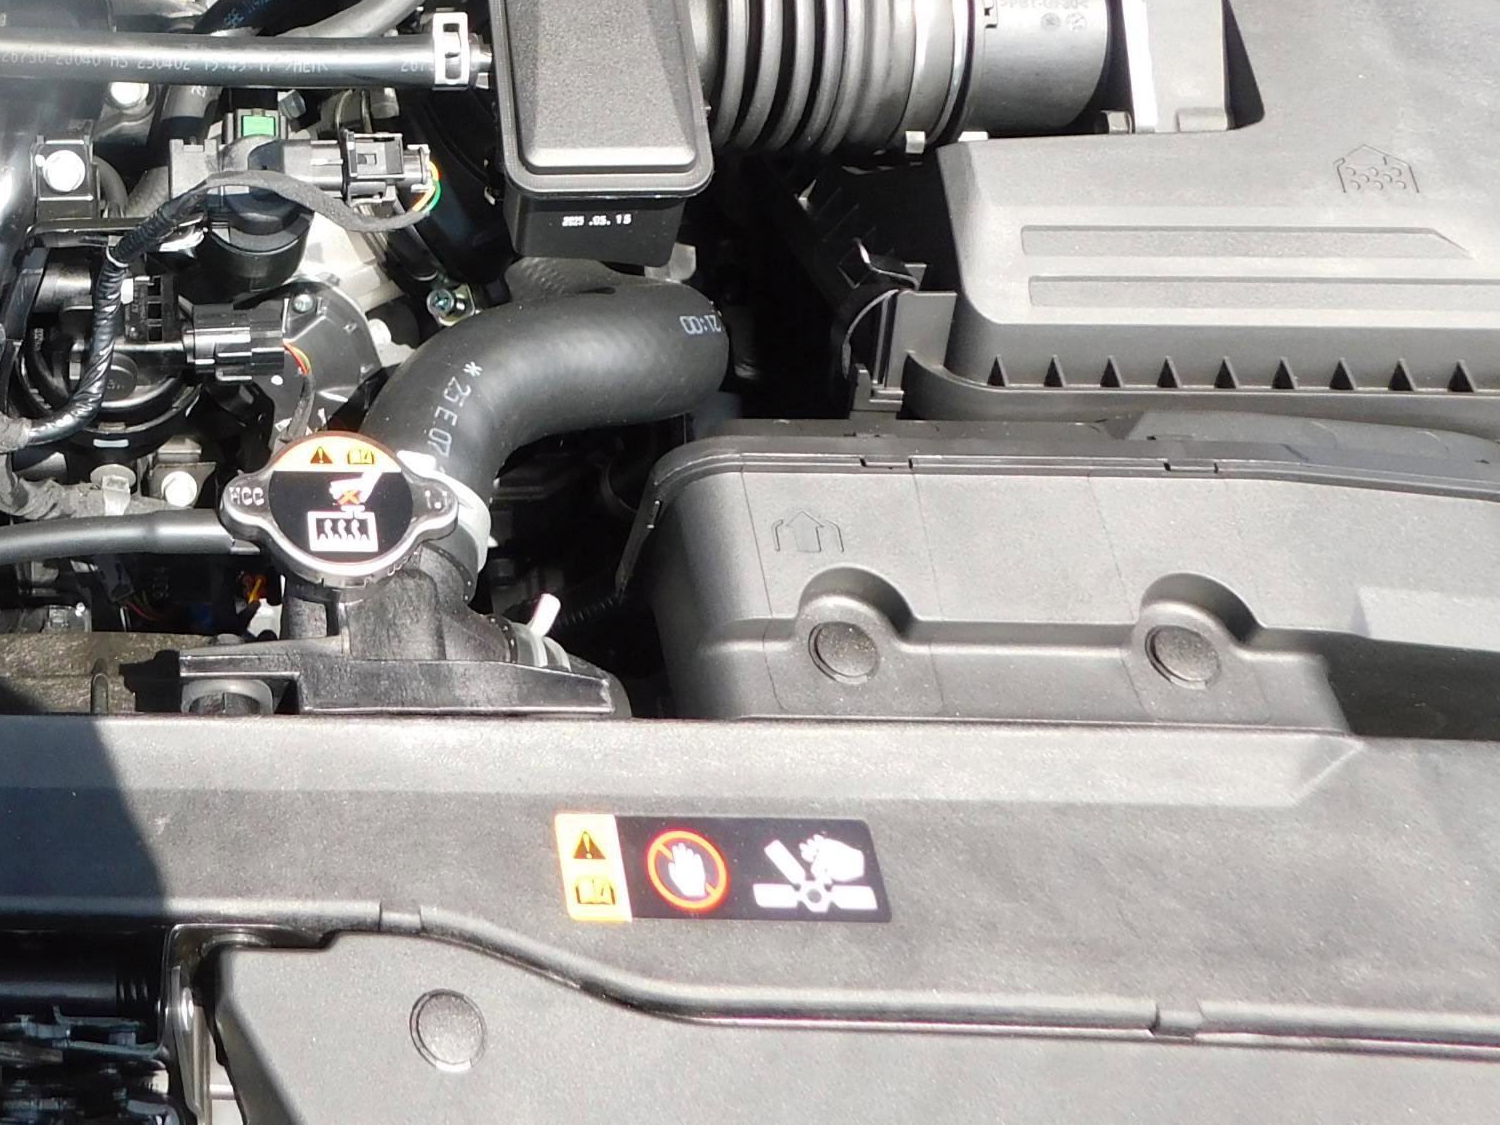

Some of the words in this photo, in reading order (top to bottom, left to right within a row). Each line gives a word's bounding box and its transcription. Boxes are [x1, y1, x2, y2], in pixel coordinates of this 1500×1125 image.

[679, 315, 722, 335] 21:00
[442, 376, 473, 408] 25
[433, 405, 458, 426] E
[228, 486, 265, 506] HCC
